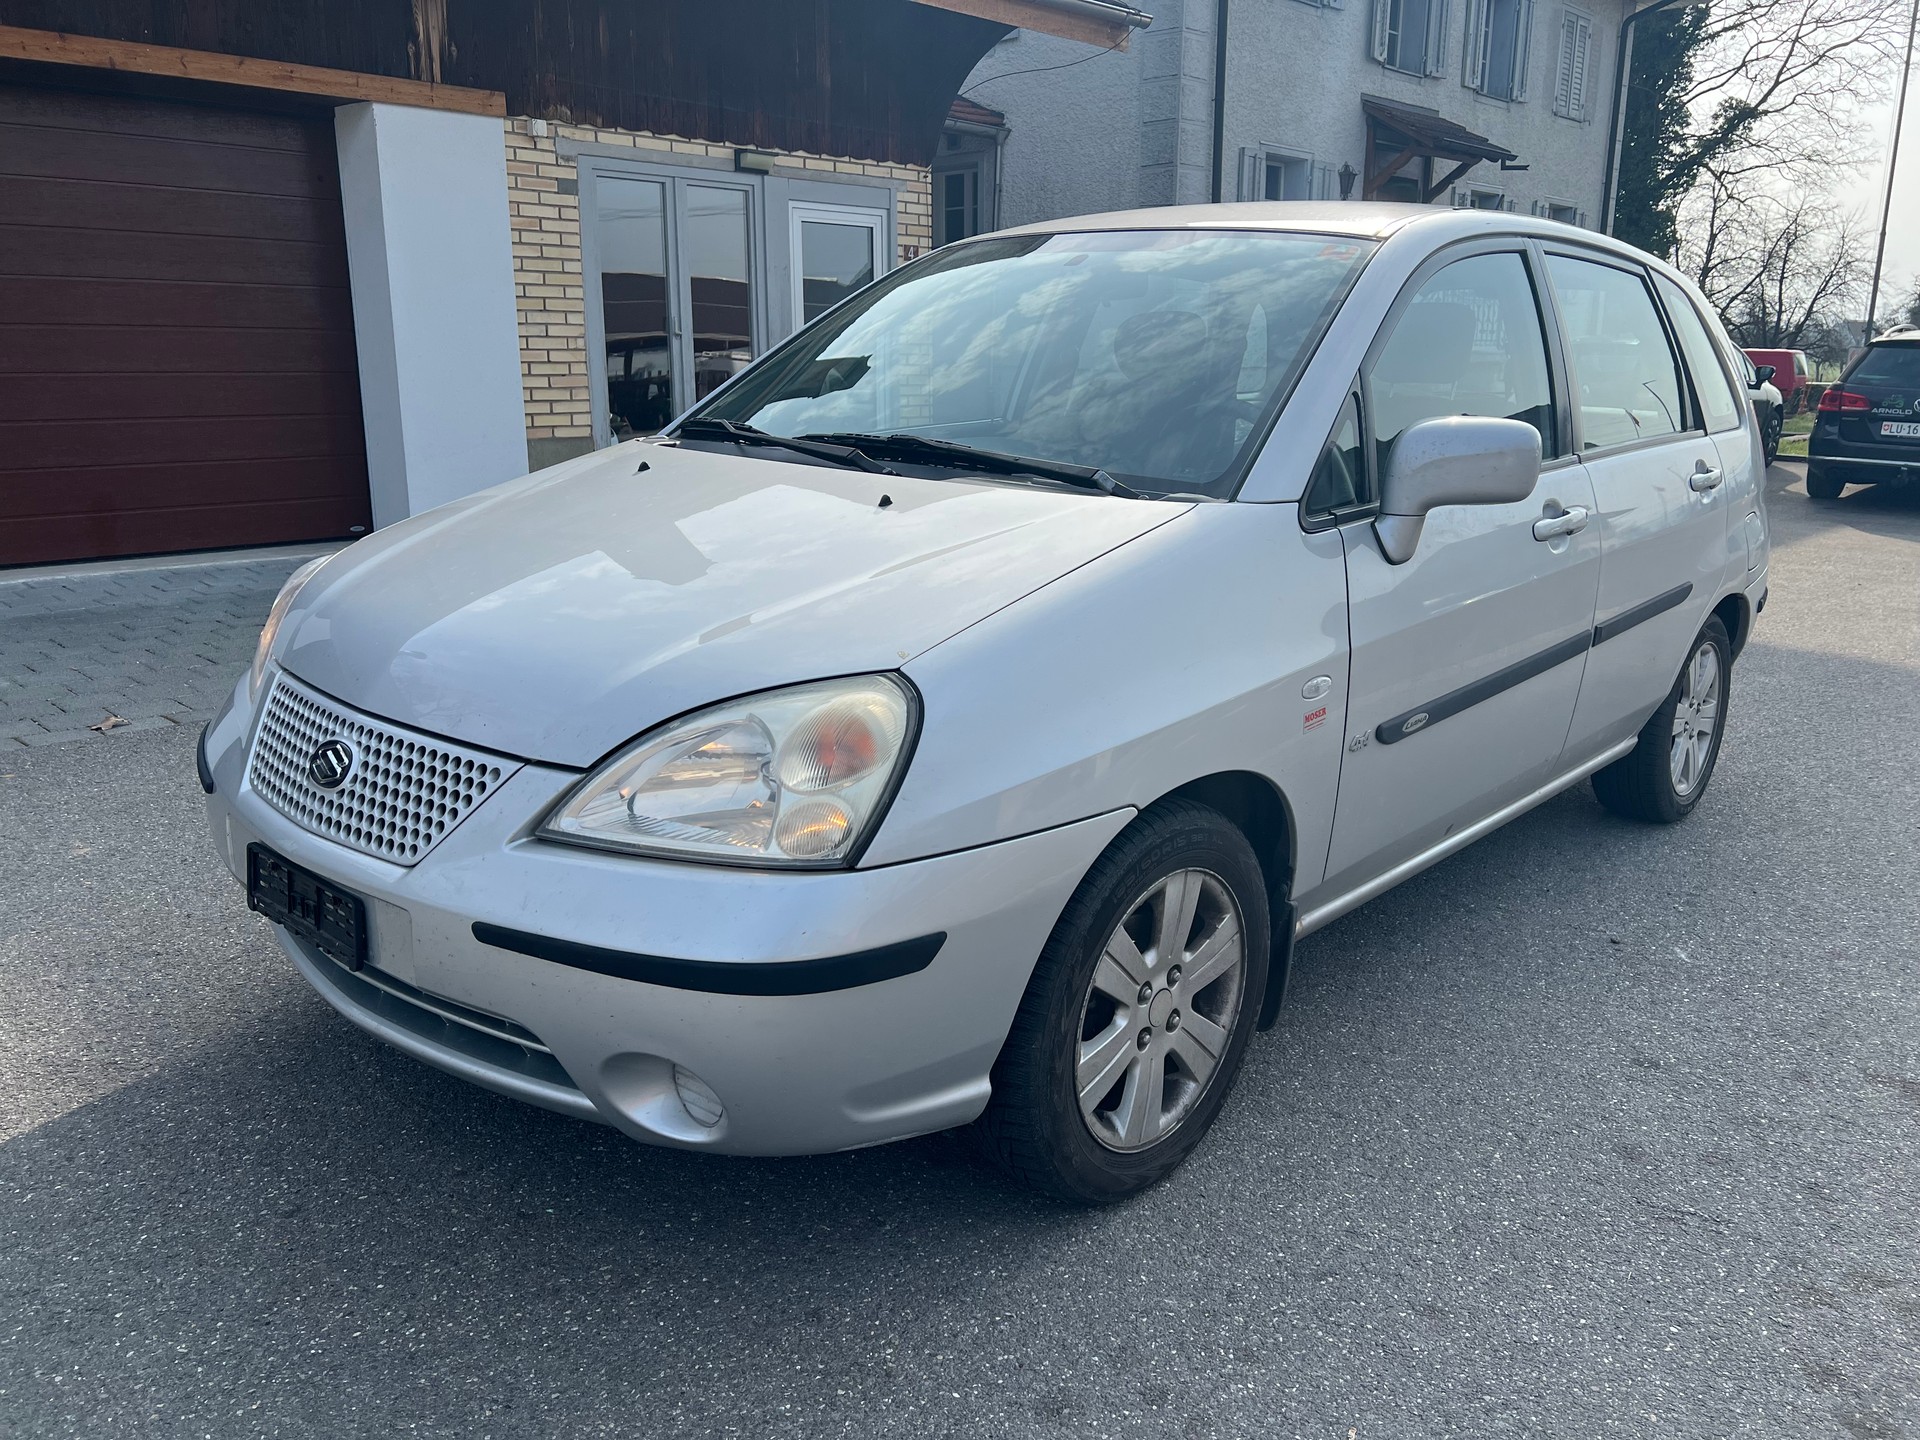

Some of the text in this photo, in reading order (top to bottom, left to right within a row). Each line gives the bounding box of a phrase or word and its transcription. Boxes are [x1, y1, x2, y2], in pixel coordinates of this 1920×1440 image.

[908, 246, 915, 260] 4
[1871, 407, 1913, 415] ARNOLD
[1304, 707, 1327, 723] MOSER
